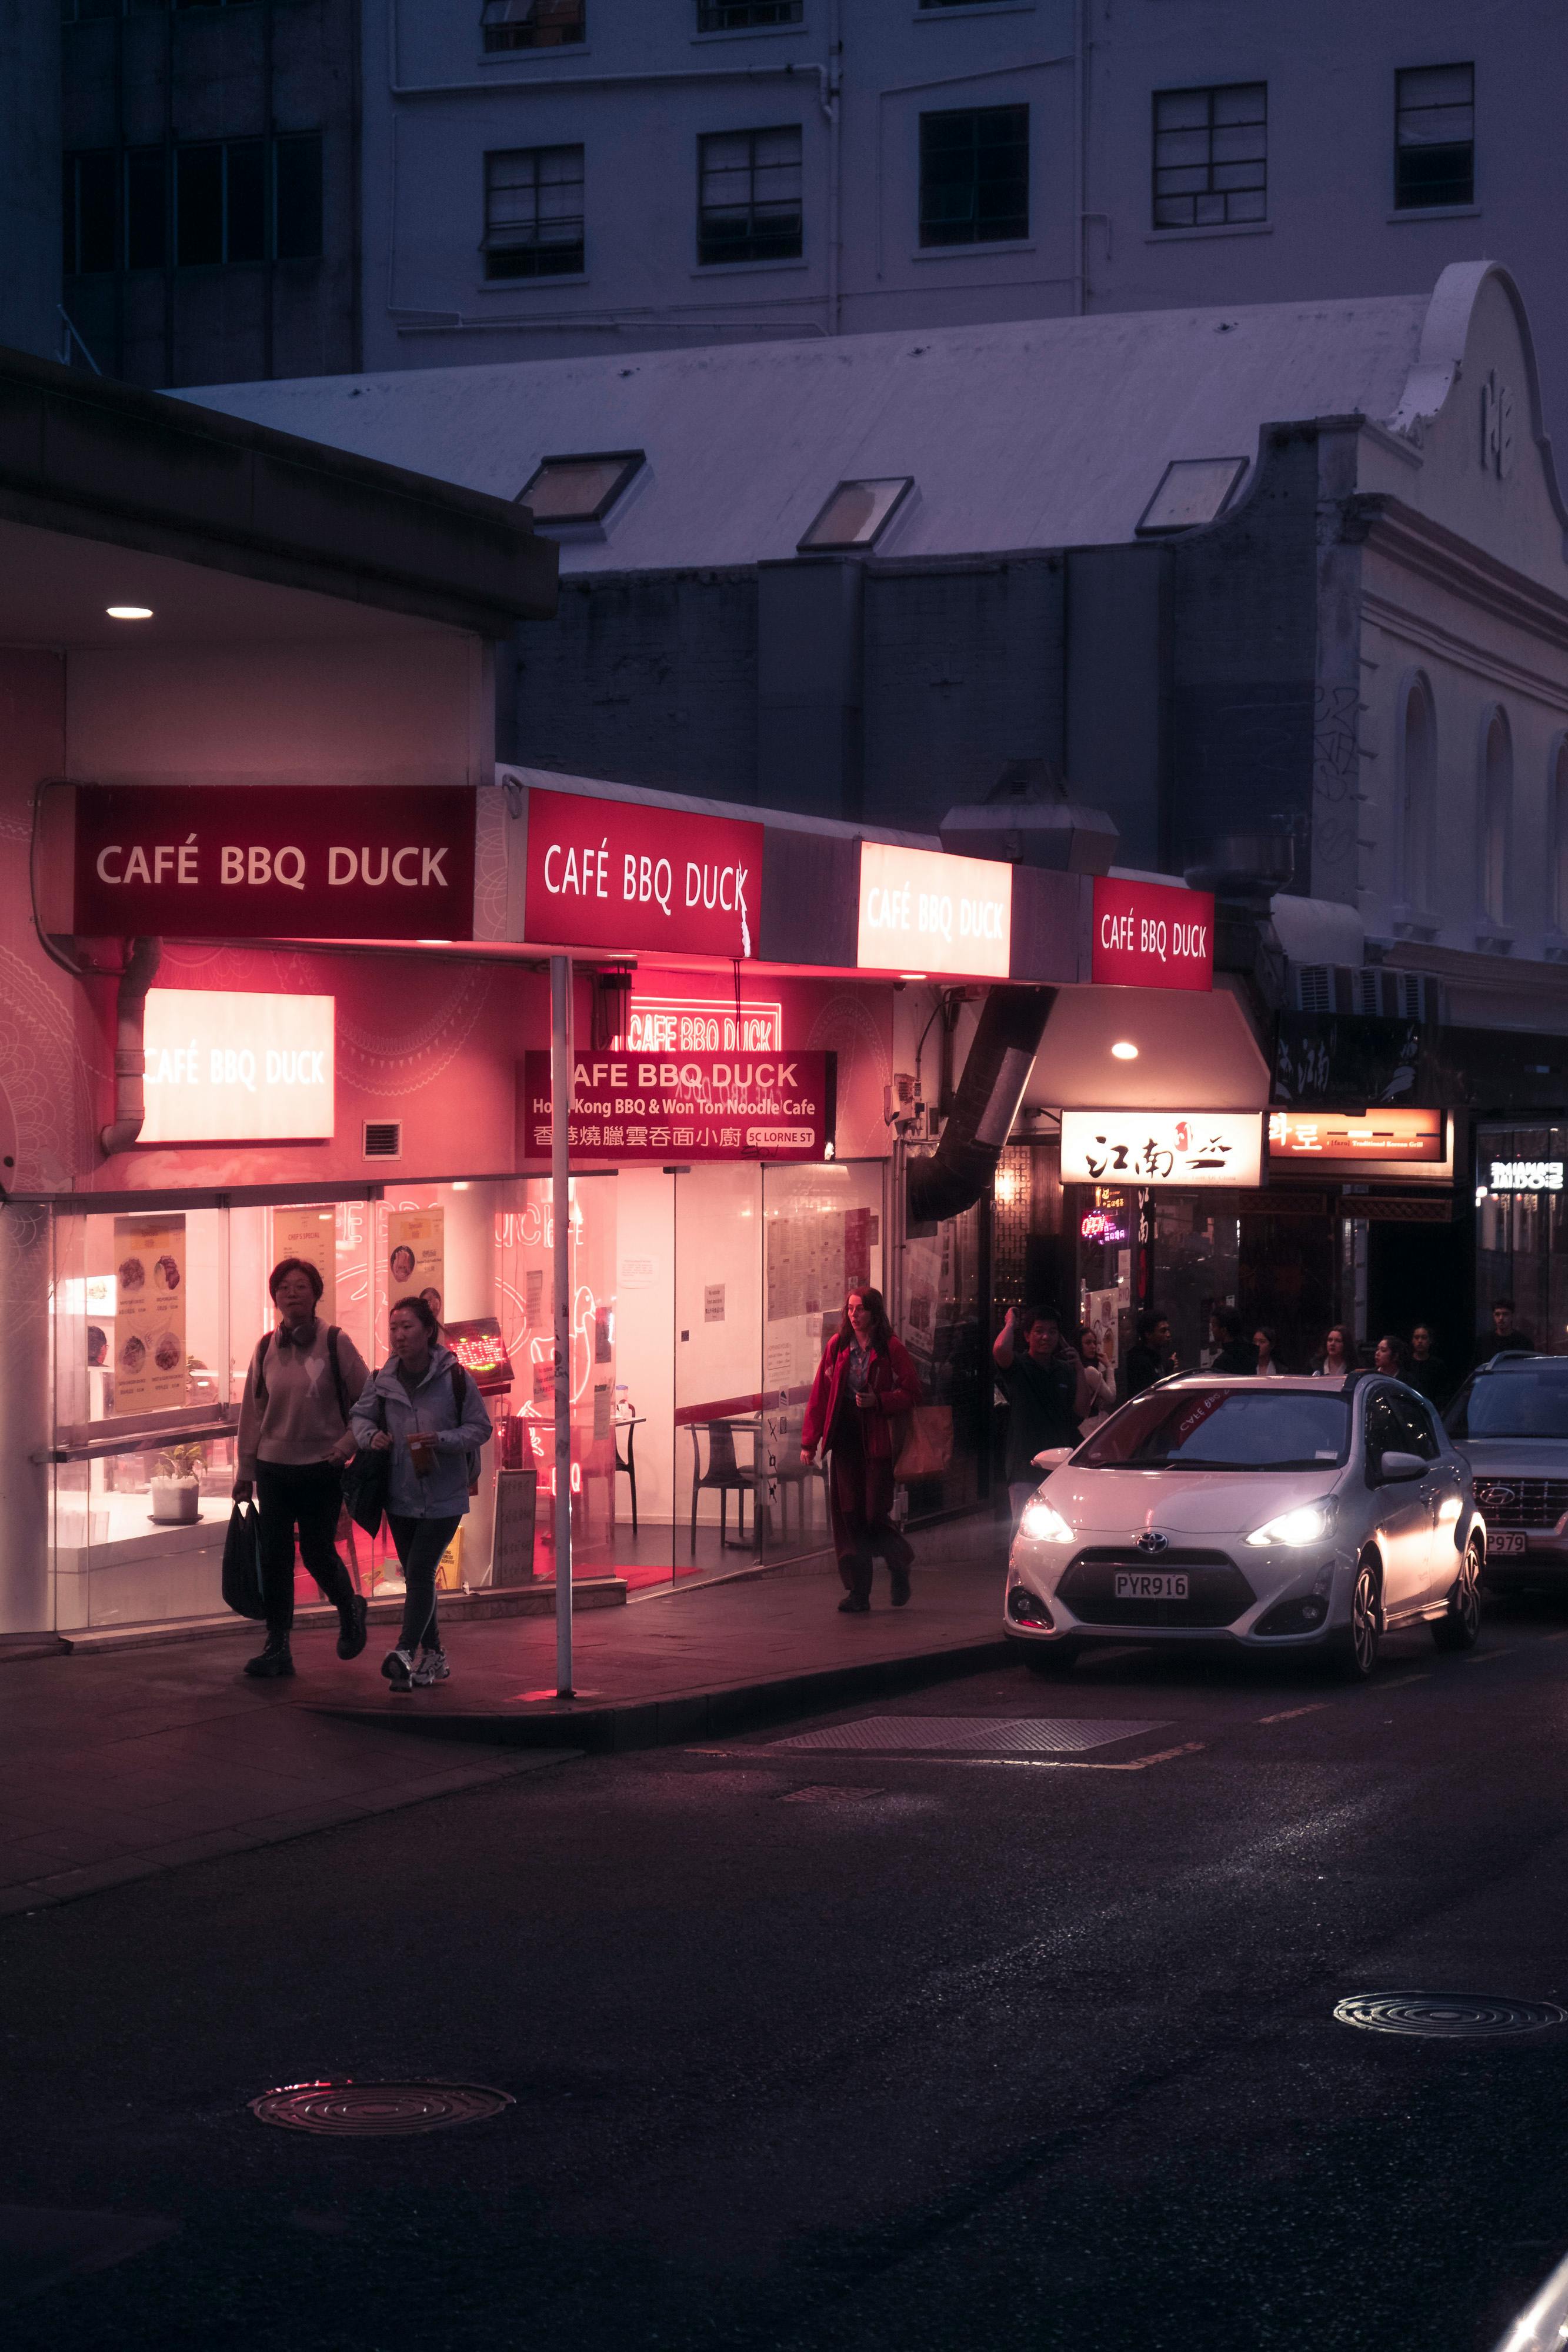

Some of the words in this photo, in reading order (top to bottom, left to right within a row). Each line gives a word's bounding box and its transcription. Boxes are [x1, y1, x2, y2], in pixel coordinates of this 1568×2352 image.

[97, 833, 198, 883] CAFÉ
[221, 846, 305, 890] BBQ
[328, 847, 448, 886] DUCK
[544, 838, 608, 898] CAFÉ
[623, 854, 671, 915] BBQ
[686, 862, 748, 912] DUCK
[868, 881, 910, 929] CAFÉ
[919, 893, 952, 942] BBQ
[960, 898, 1003, 939] DUCK
[1102, 908, 1134, 950] CAFÉ
[1141, 919, 1167, 962] BBQ
[1173, 922, 1206, 958] DUCK
[628, 1014, 677, 1051] CAFE
[724, 1017, 772, 1051] DUCK
[144, 1039, 199, 1084] CAFÉ
[211, 1050, 256, 1091] BBQ
[266, 1050, 324, 1084] DUCK
[573, 1064, 628, 1087] AFE
[638, 1063, 702, 1089] BBQ
[713, 1063, 798, 1087] DUCK
[533, 1098, 570, 1117] Ho
[575, 1098, 612, 1117] Kong
[615, 1099, 646, 1115] BBQ
[648, 1099, 660, 1114] &
[662, 1099, 694, 1115] Won
[696, 1099, 723, 1115] Ton
[727, 1099, 779, 1115] Noodle
[782, 1099, 816, 1115] Cafe
[749, 1132, 762, 1142] 5C
[764, 1132, 798, 1143] LORNE
[800, 1132, 813, 1142] ST
[1082, 1216, 1106, 1236] OPEN
[1117, 1576, 1186, 1596] PYR916
